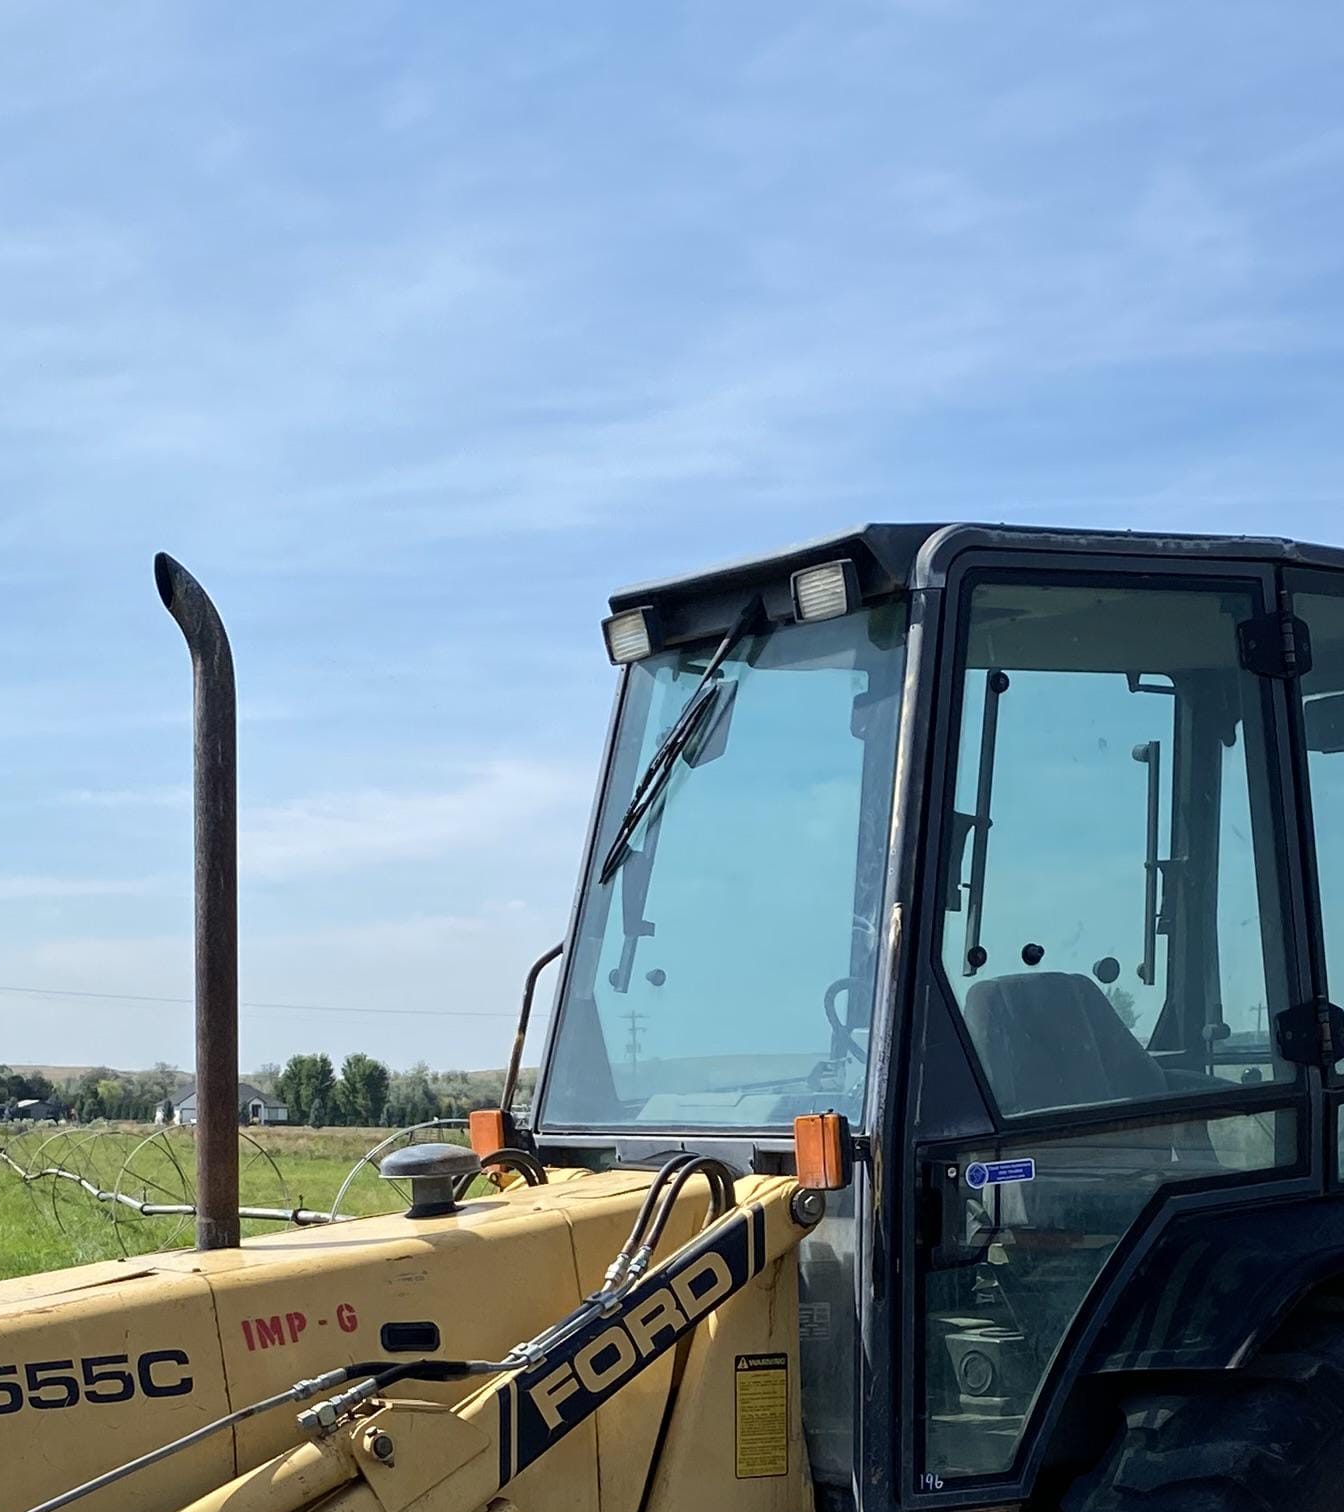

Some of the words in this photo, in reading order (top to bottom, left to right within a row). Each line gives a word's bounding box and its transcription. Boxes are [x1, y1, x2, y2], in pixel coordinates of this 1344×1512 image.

[240, 1312, 307, 1352] IMP
[337, 1302, 358, 1334] G
[528, 1251, 733, 1430] FORD
[920, 1472, 944, 1490] 196
